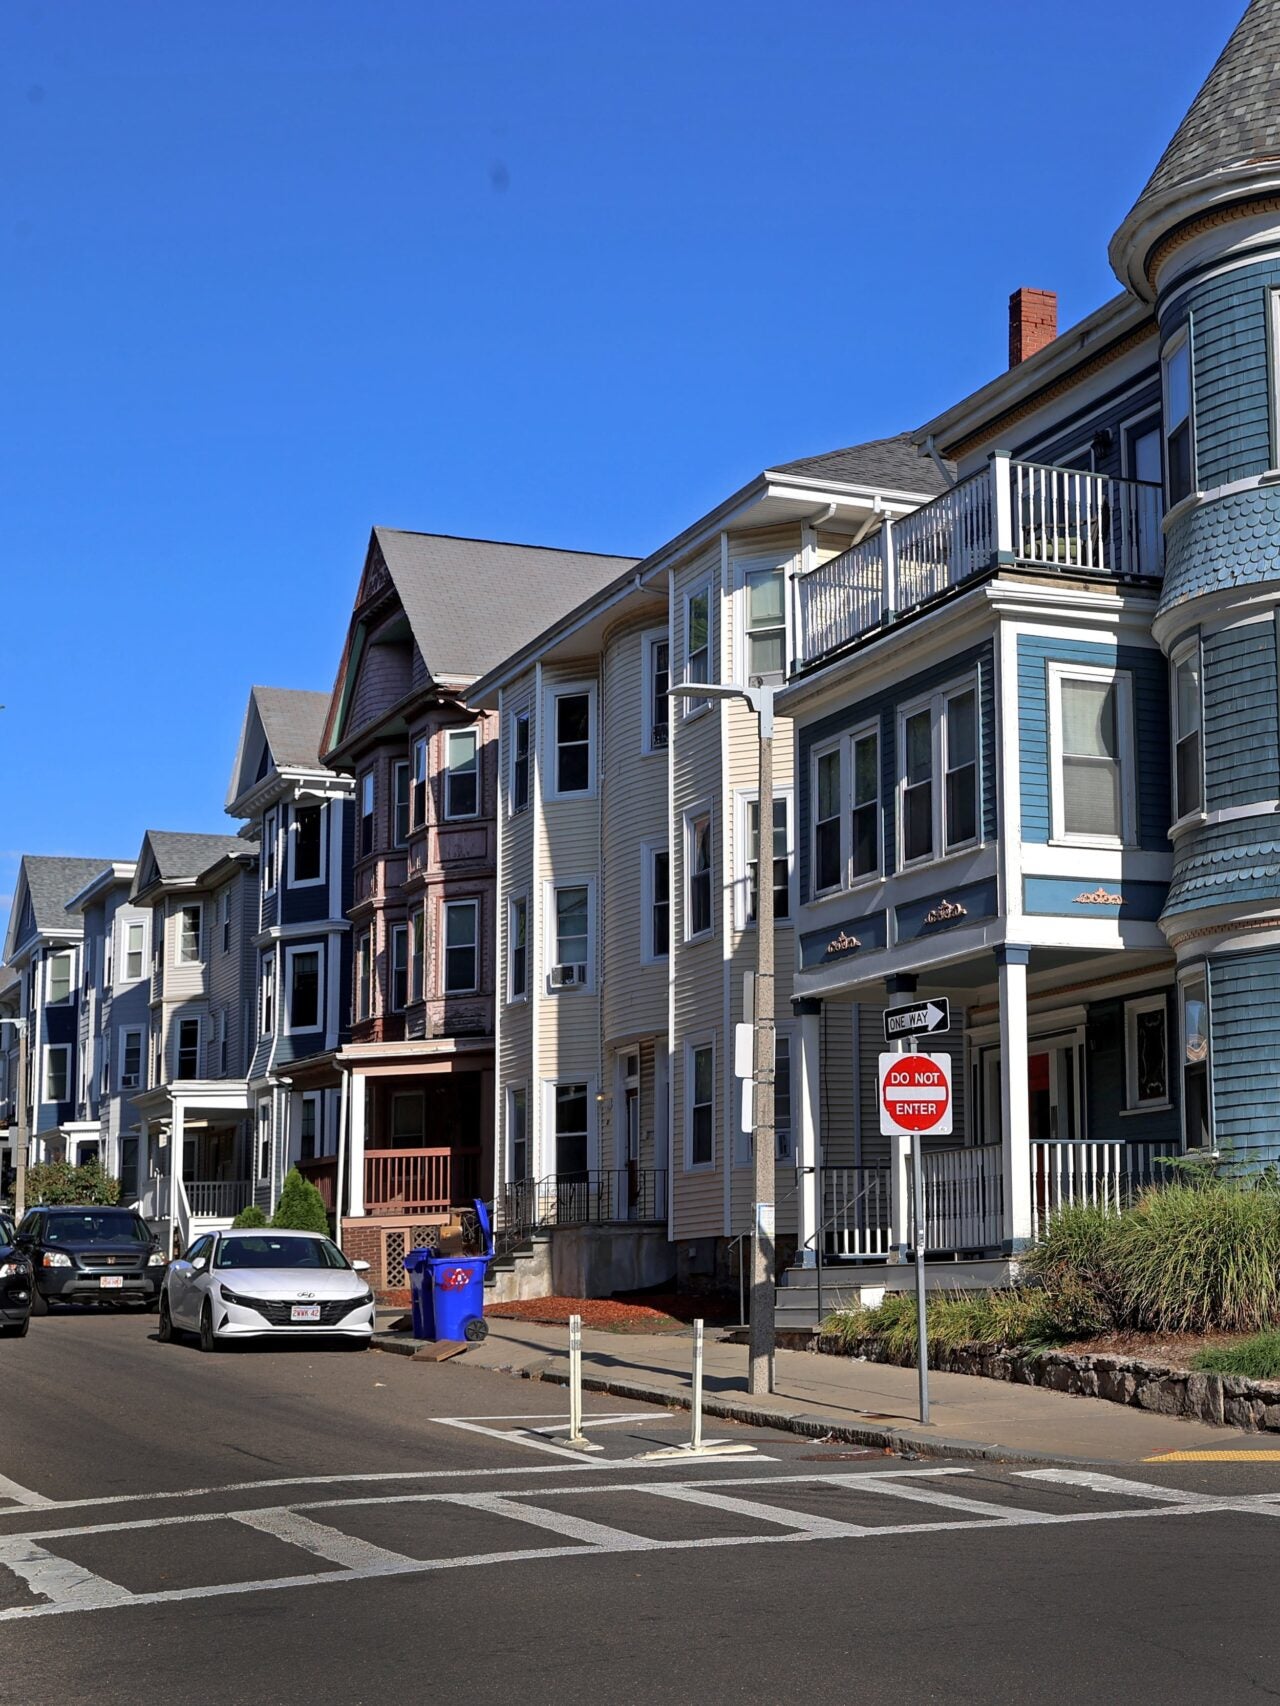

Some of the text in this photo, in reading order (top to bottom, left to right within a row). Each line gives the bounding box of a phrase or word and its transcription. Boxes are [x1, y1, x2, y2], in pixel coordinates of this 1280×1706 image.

[889, 1010, 929, 1031] ONE WAY
[891, 1072, 941, 1084] DO NOT
[896, 1103, 937, 1115] ENTER
